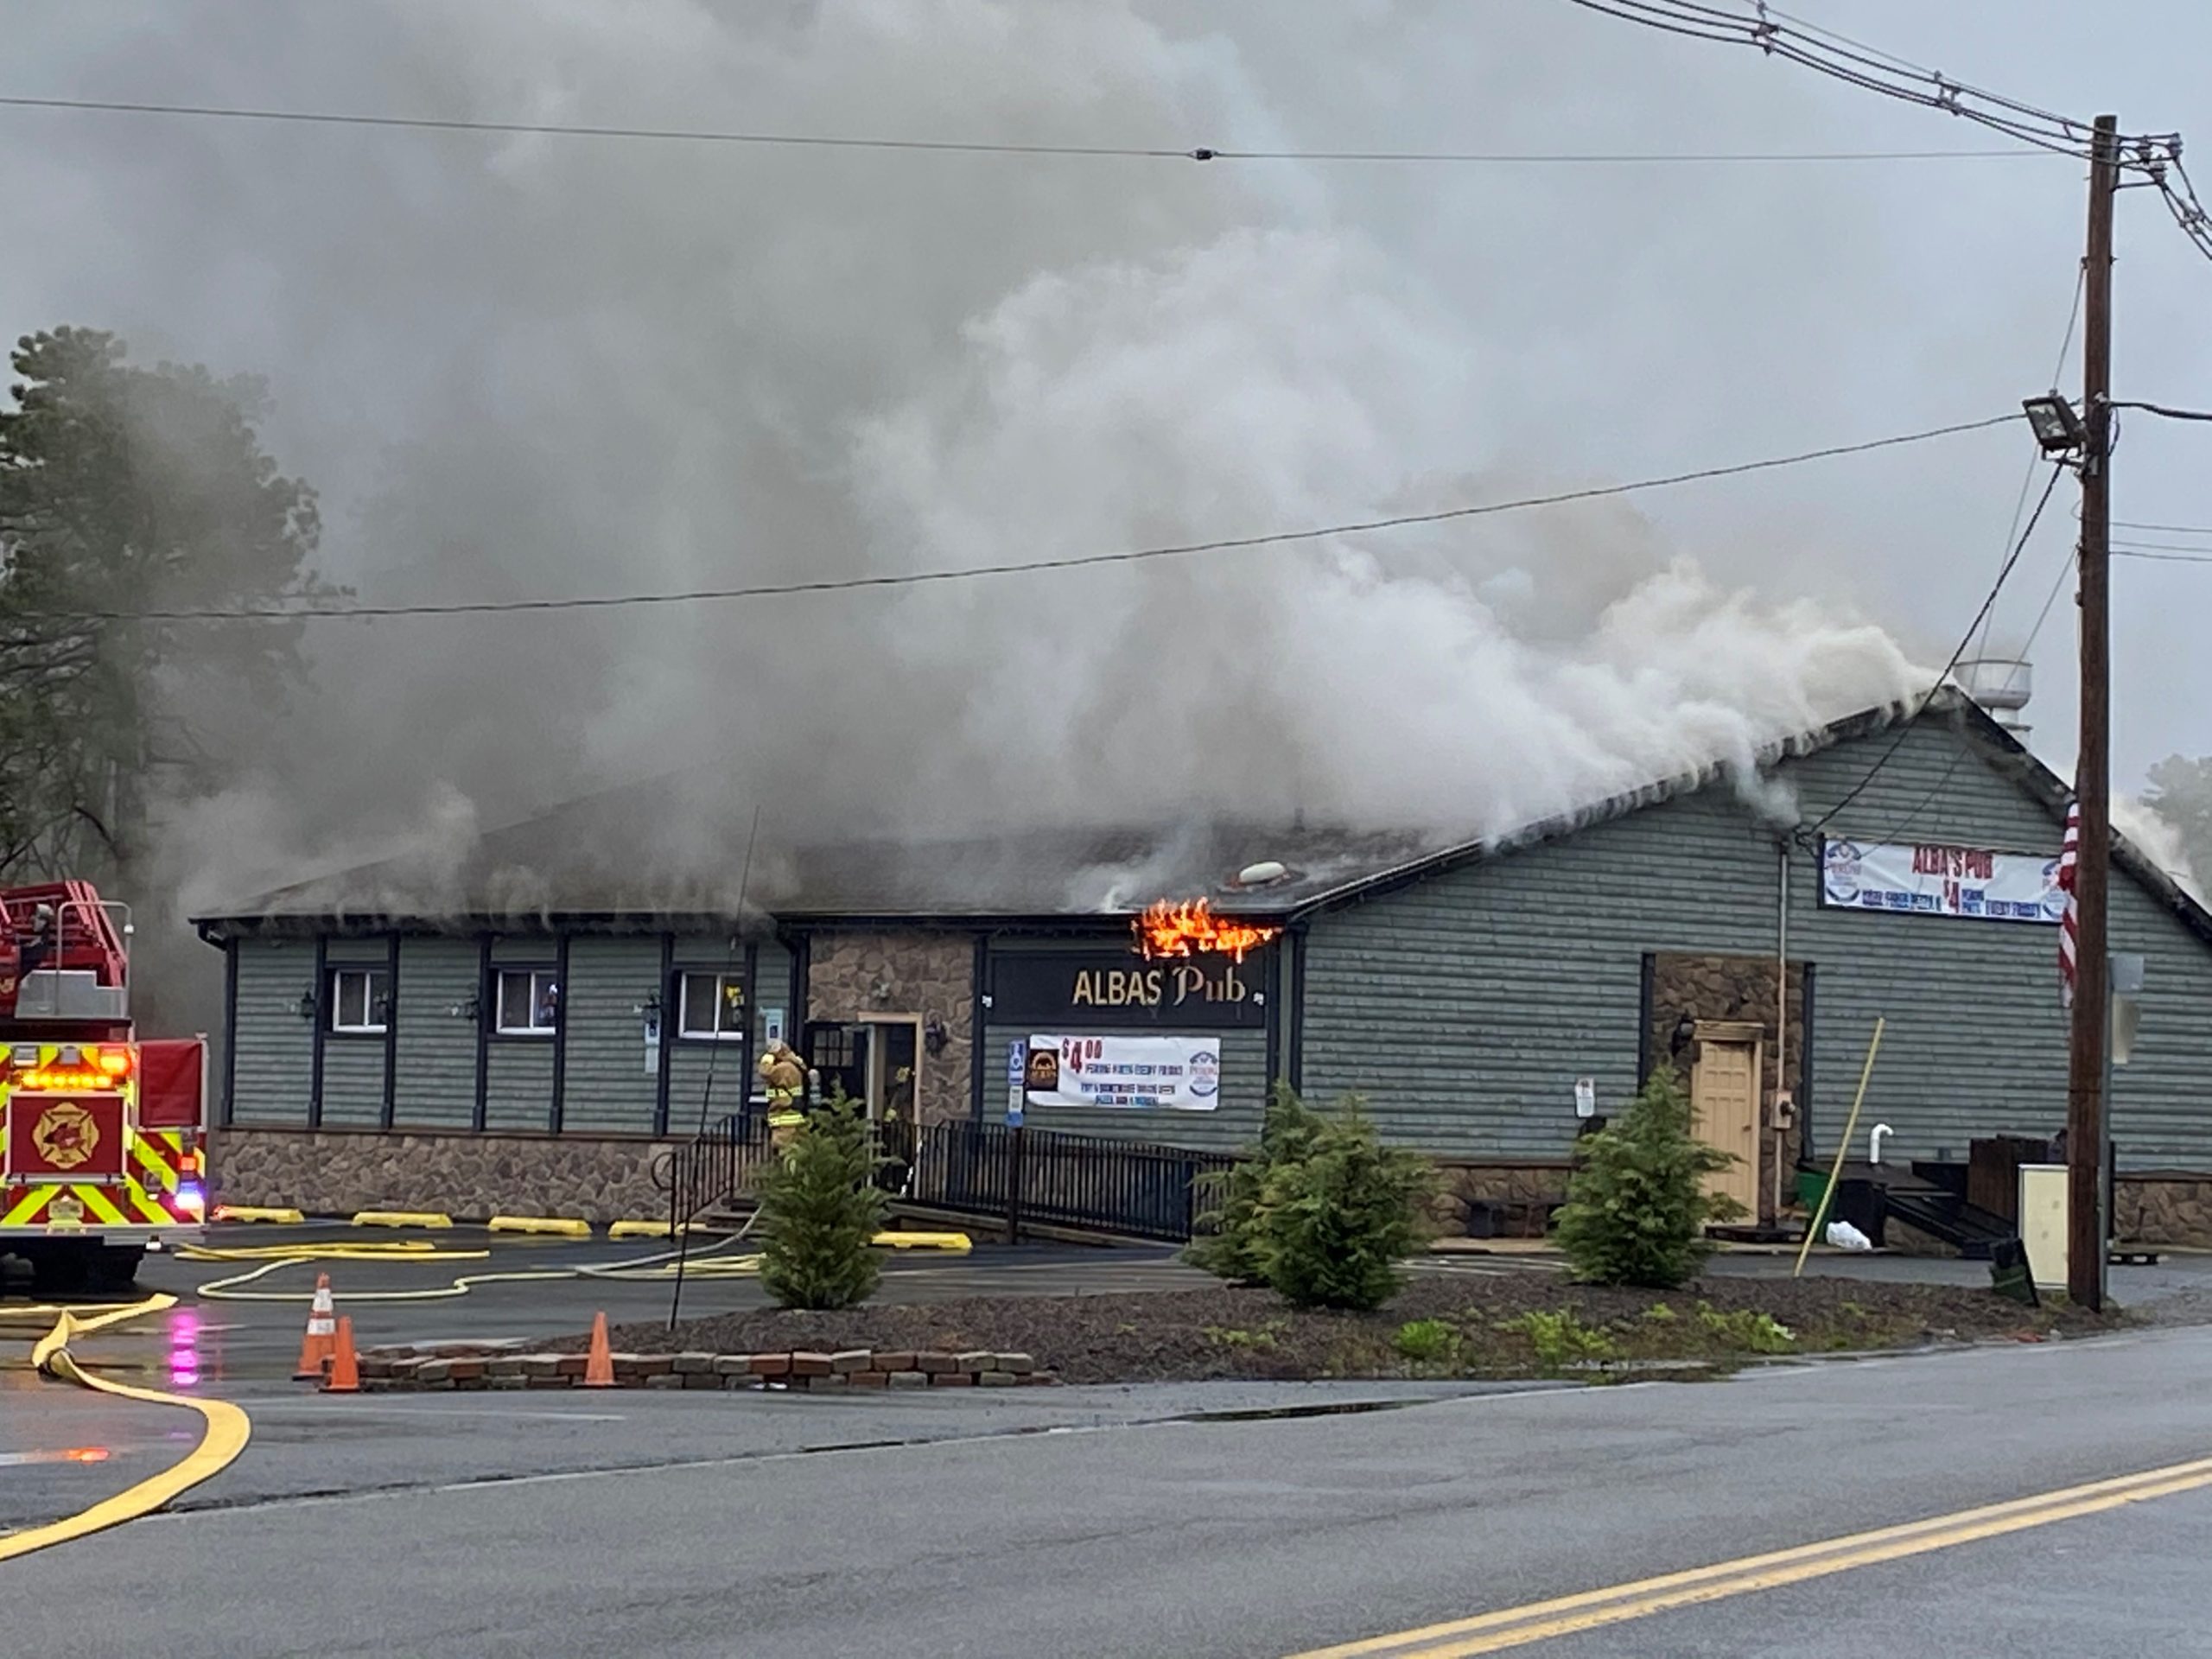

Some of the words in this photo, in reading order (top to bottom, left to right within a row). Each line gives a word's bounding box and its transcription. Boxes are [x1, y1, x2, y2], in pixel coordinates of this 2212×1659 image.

[1965, 850, 1993, 880] PUB
[1072, 969, 1162, 1006] ALBAS
[1172, 965, 1246, 1006] Pub
